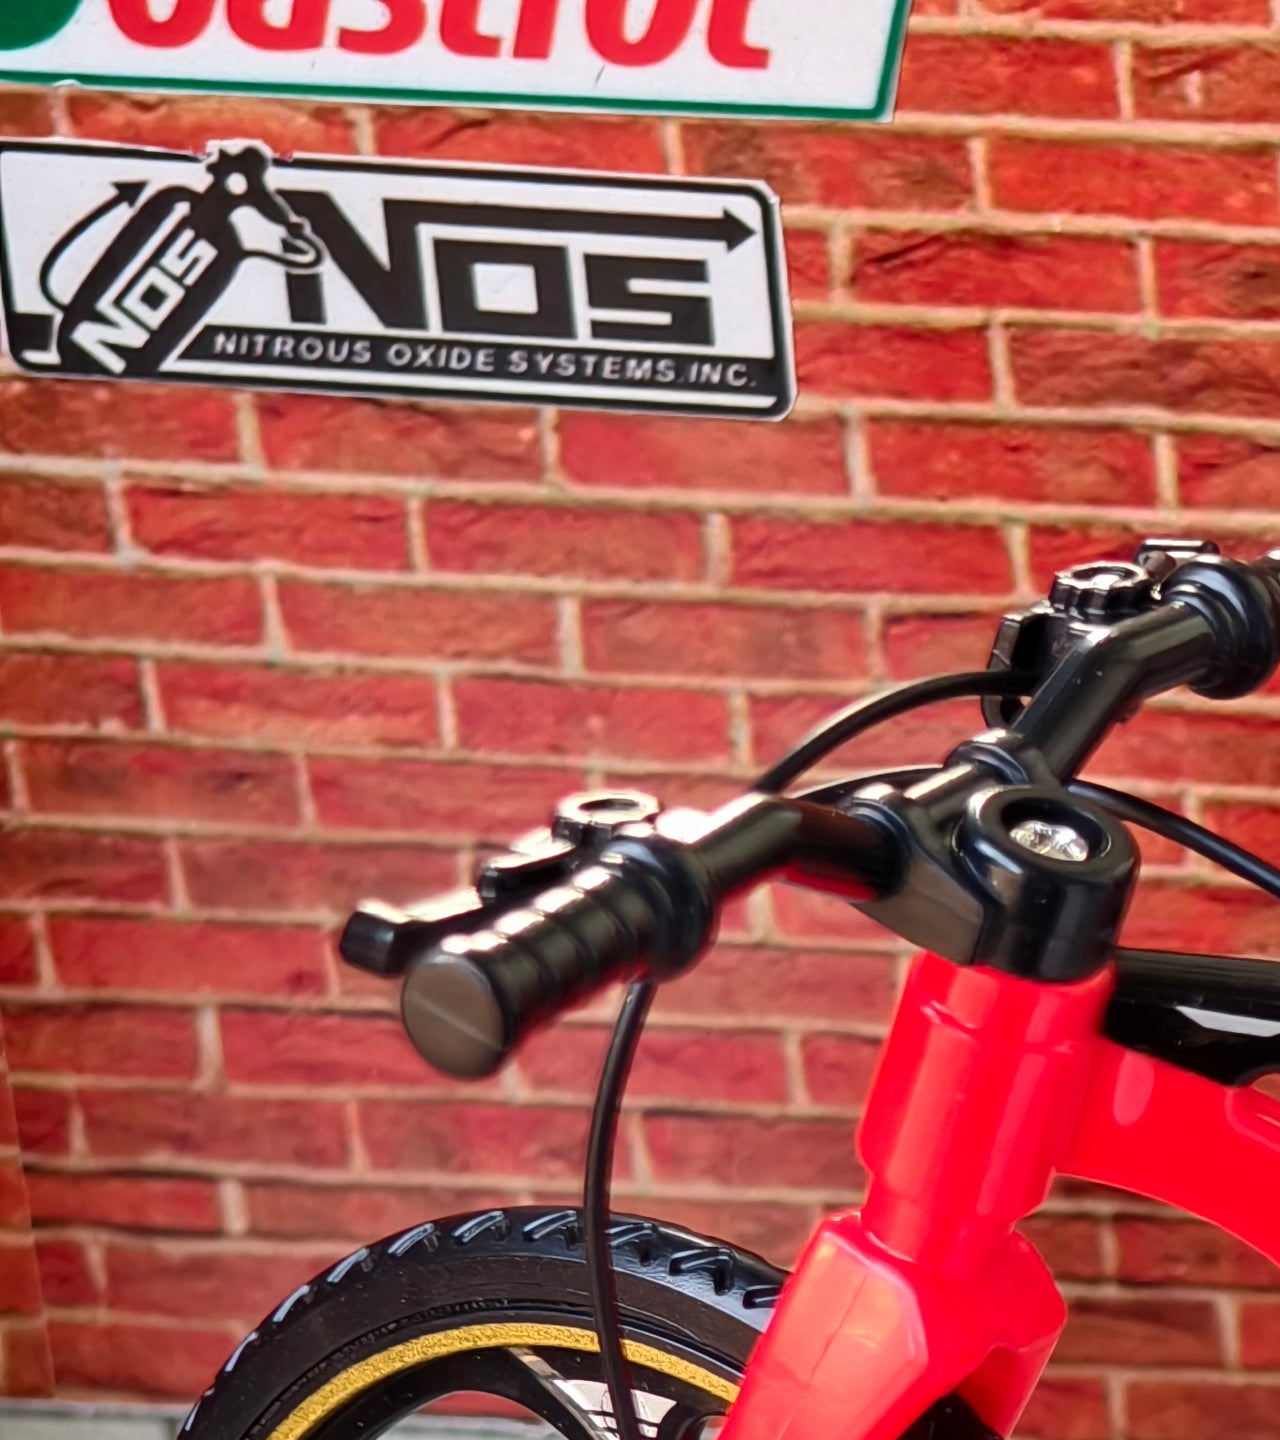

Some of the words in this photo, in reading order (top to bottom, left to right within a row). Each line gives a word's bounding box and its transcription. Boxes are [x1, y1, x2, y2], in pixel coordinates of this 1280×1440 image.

[70, 224, 219, 375] NOS
[276, 188, 716, 348] NOS
[213, 331, 373, 364] NITROUS
[386, 342, 496, 373] OXIDE
